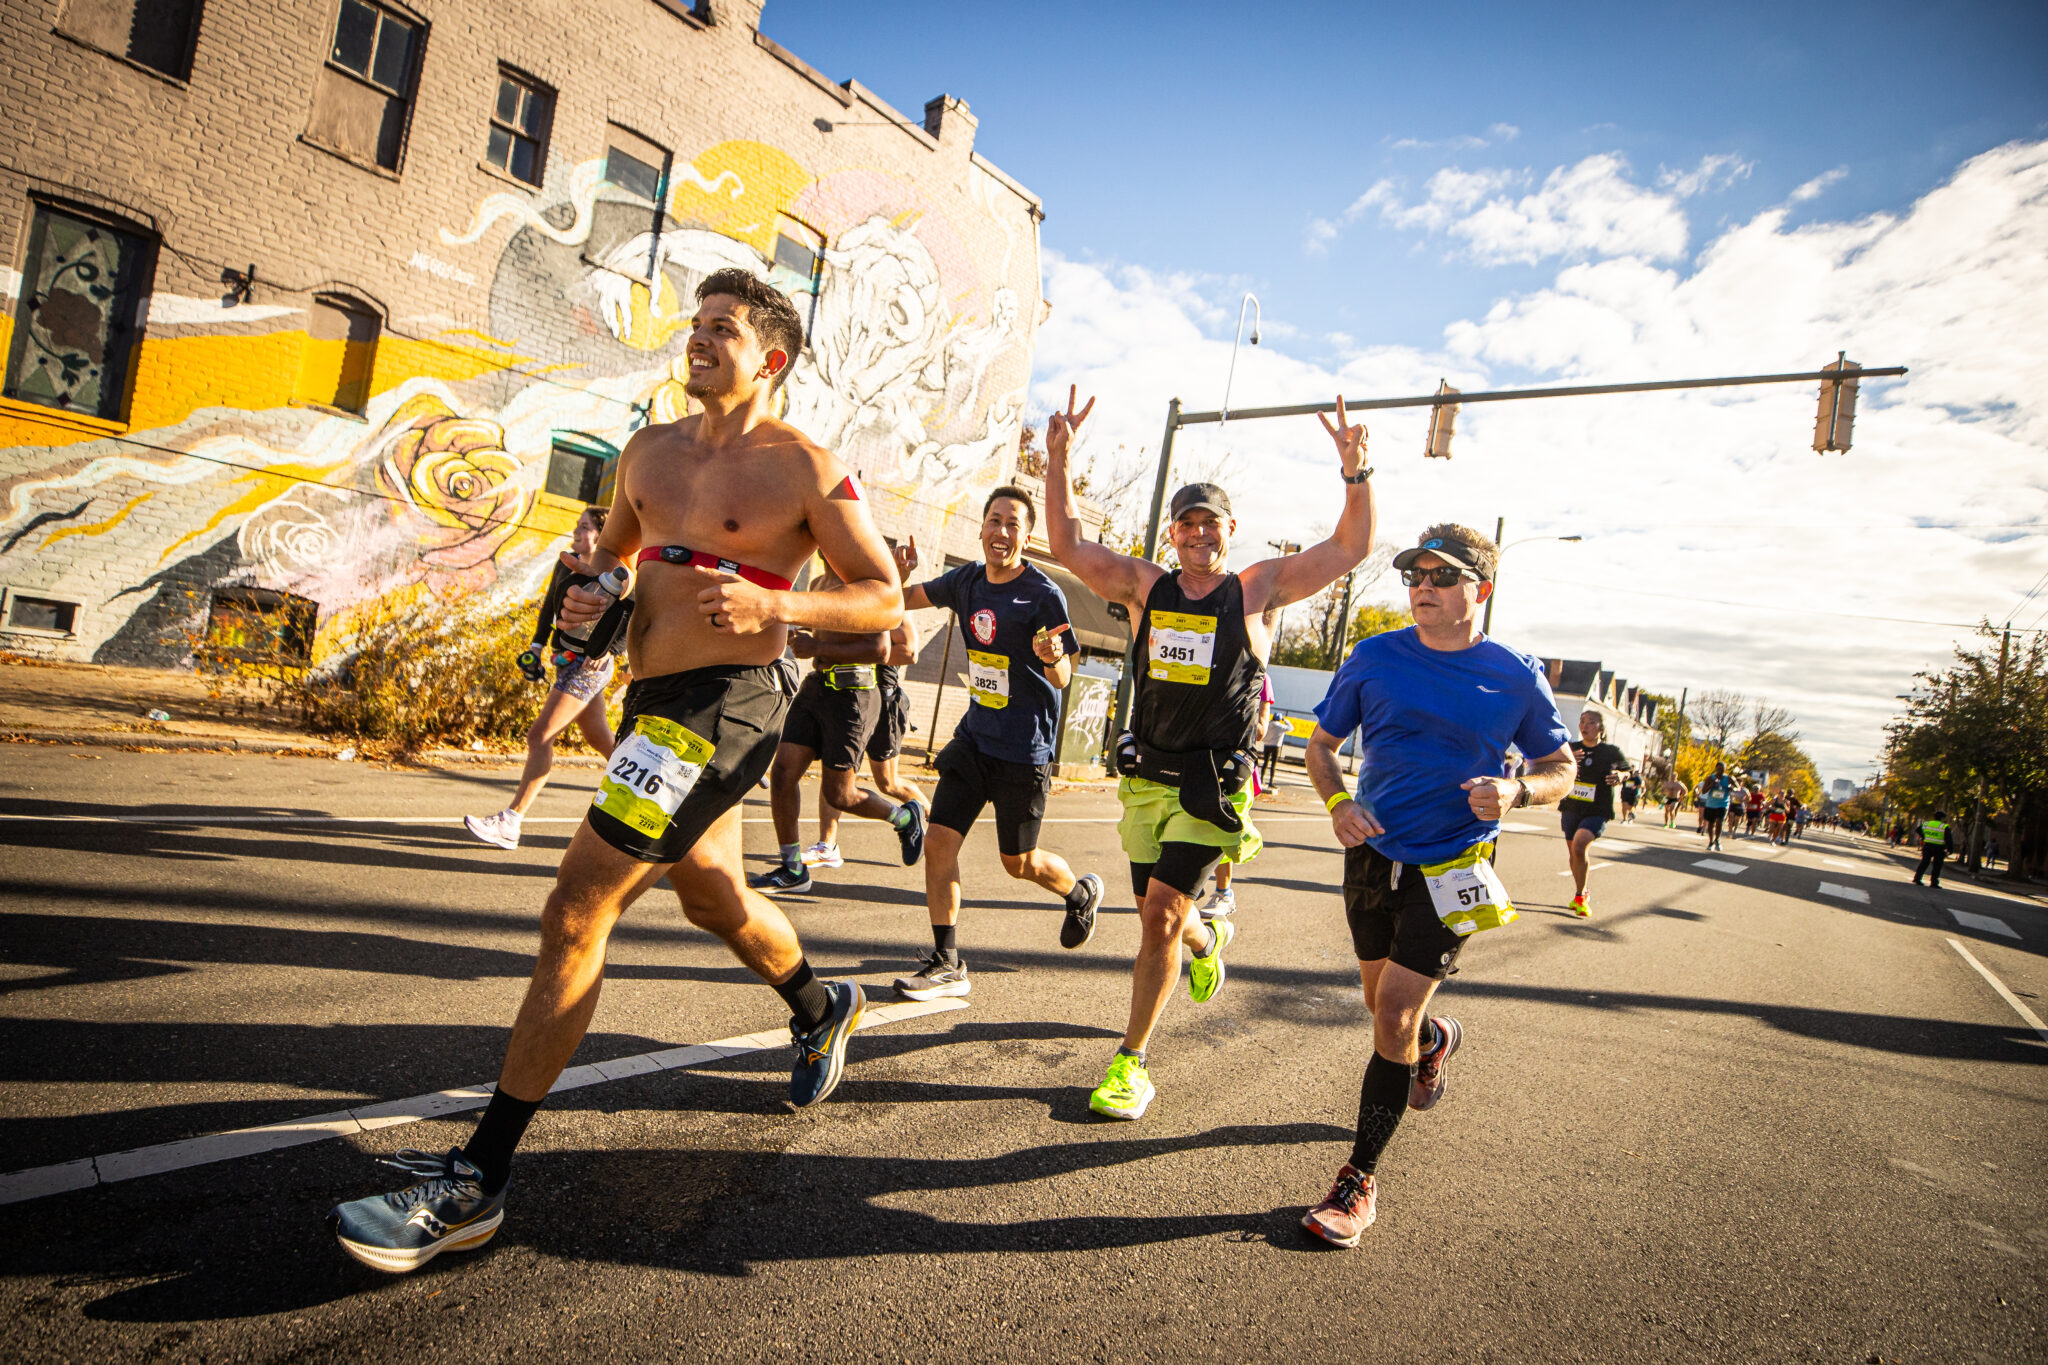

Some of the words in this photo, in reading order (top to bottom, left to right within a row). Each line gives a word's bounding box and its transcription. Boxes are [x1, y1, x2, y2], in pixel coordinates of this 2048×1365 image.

[1159, 645, 1195, 662] 3451
[974, 676, 998, 691] 3825
[687, 741, 702, 754] 2216
[611, 756, 664, 795] 2216
[638, 819, 655, 831] 2216
